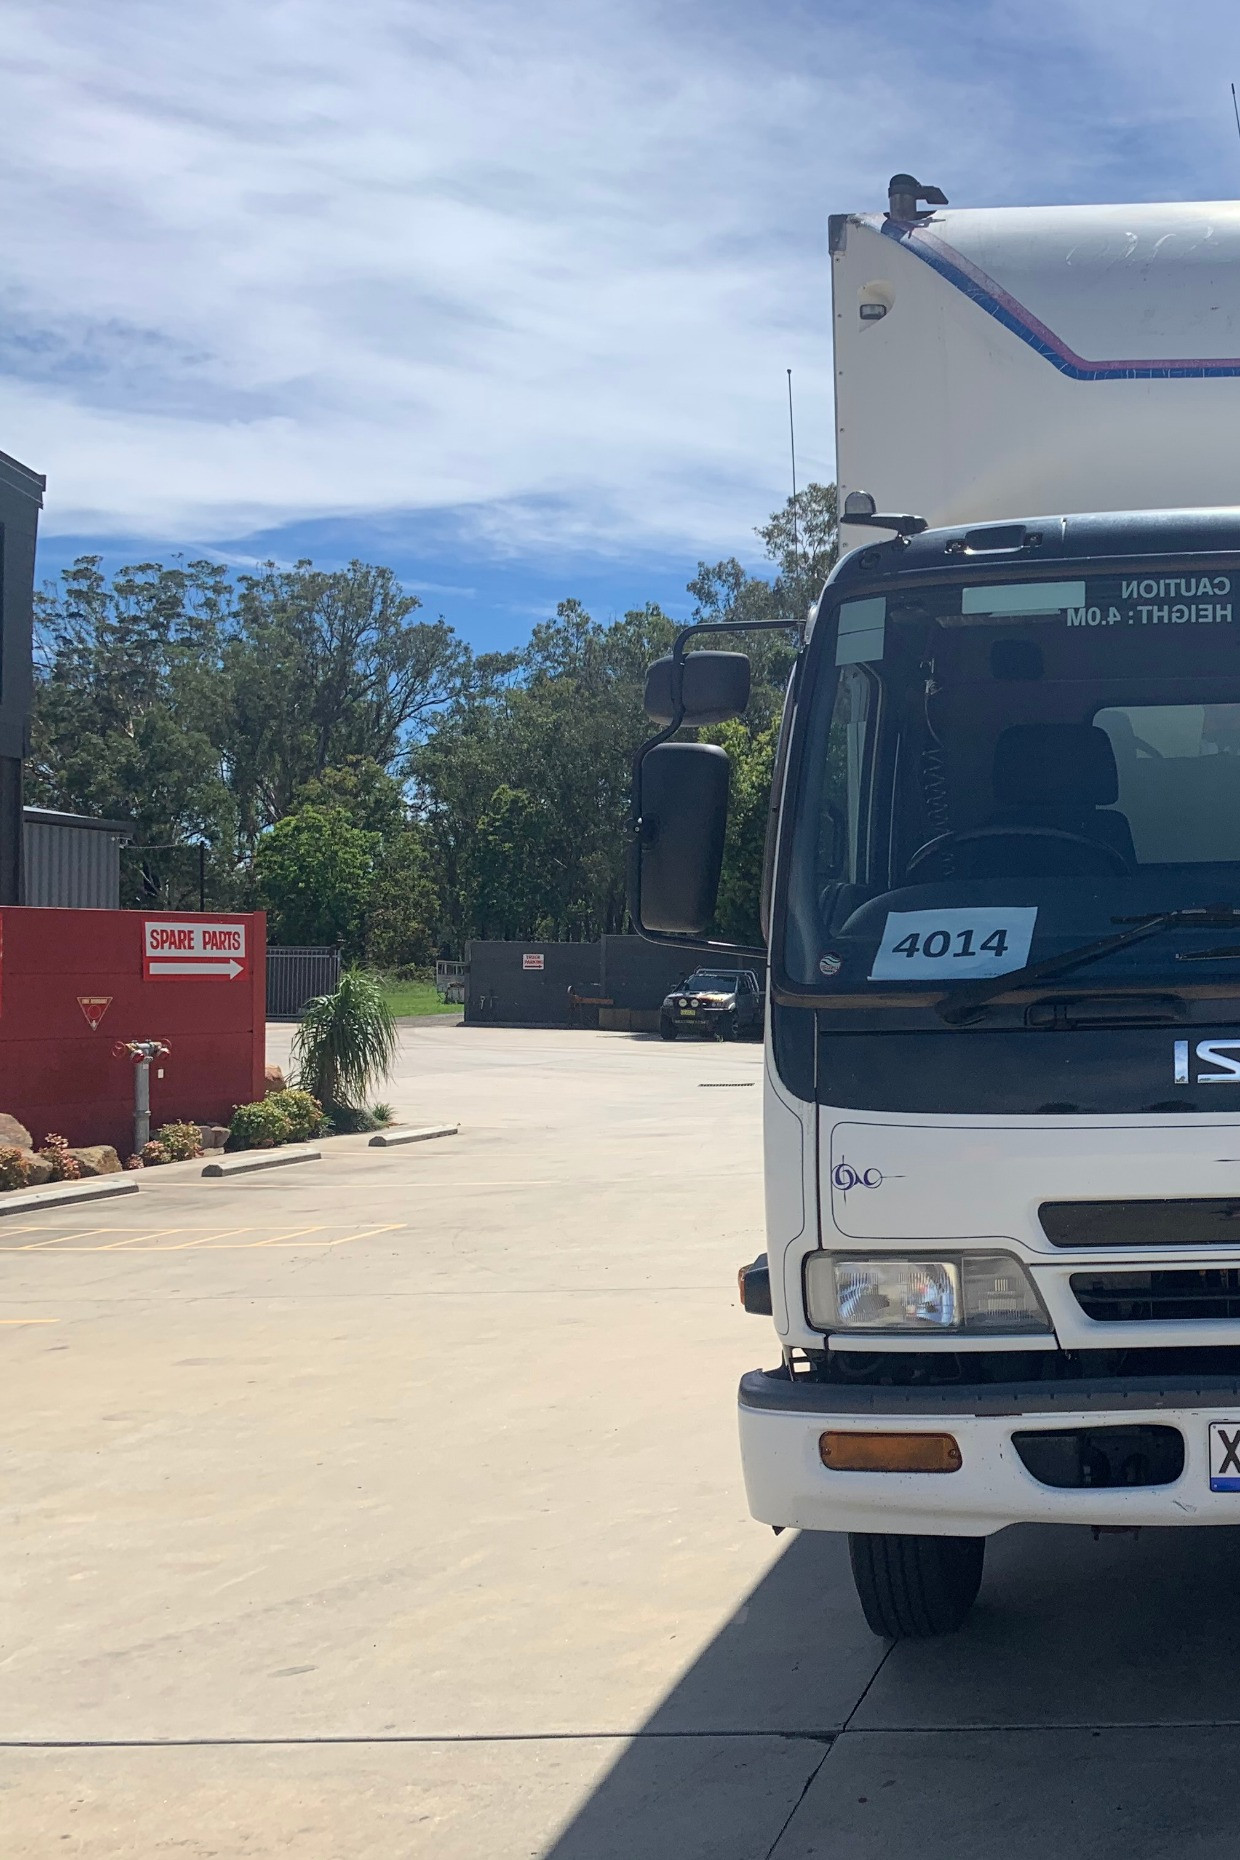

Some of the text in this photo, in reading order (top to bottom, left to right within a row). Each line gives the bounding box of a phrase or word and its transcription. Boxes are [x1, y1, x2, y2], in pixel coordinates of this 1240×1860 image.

[150, 929, 241, 950] SPARE PARTS
[891, 928, 1010, 960] 4014
